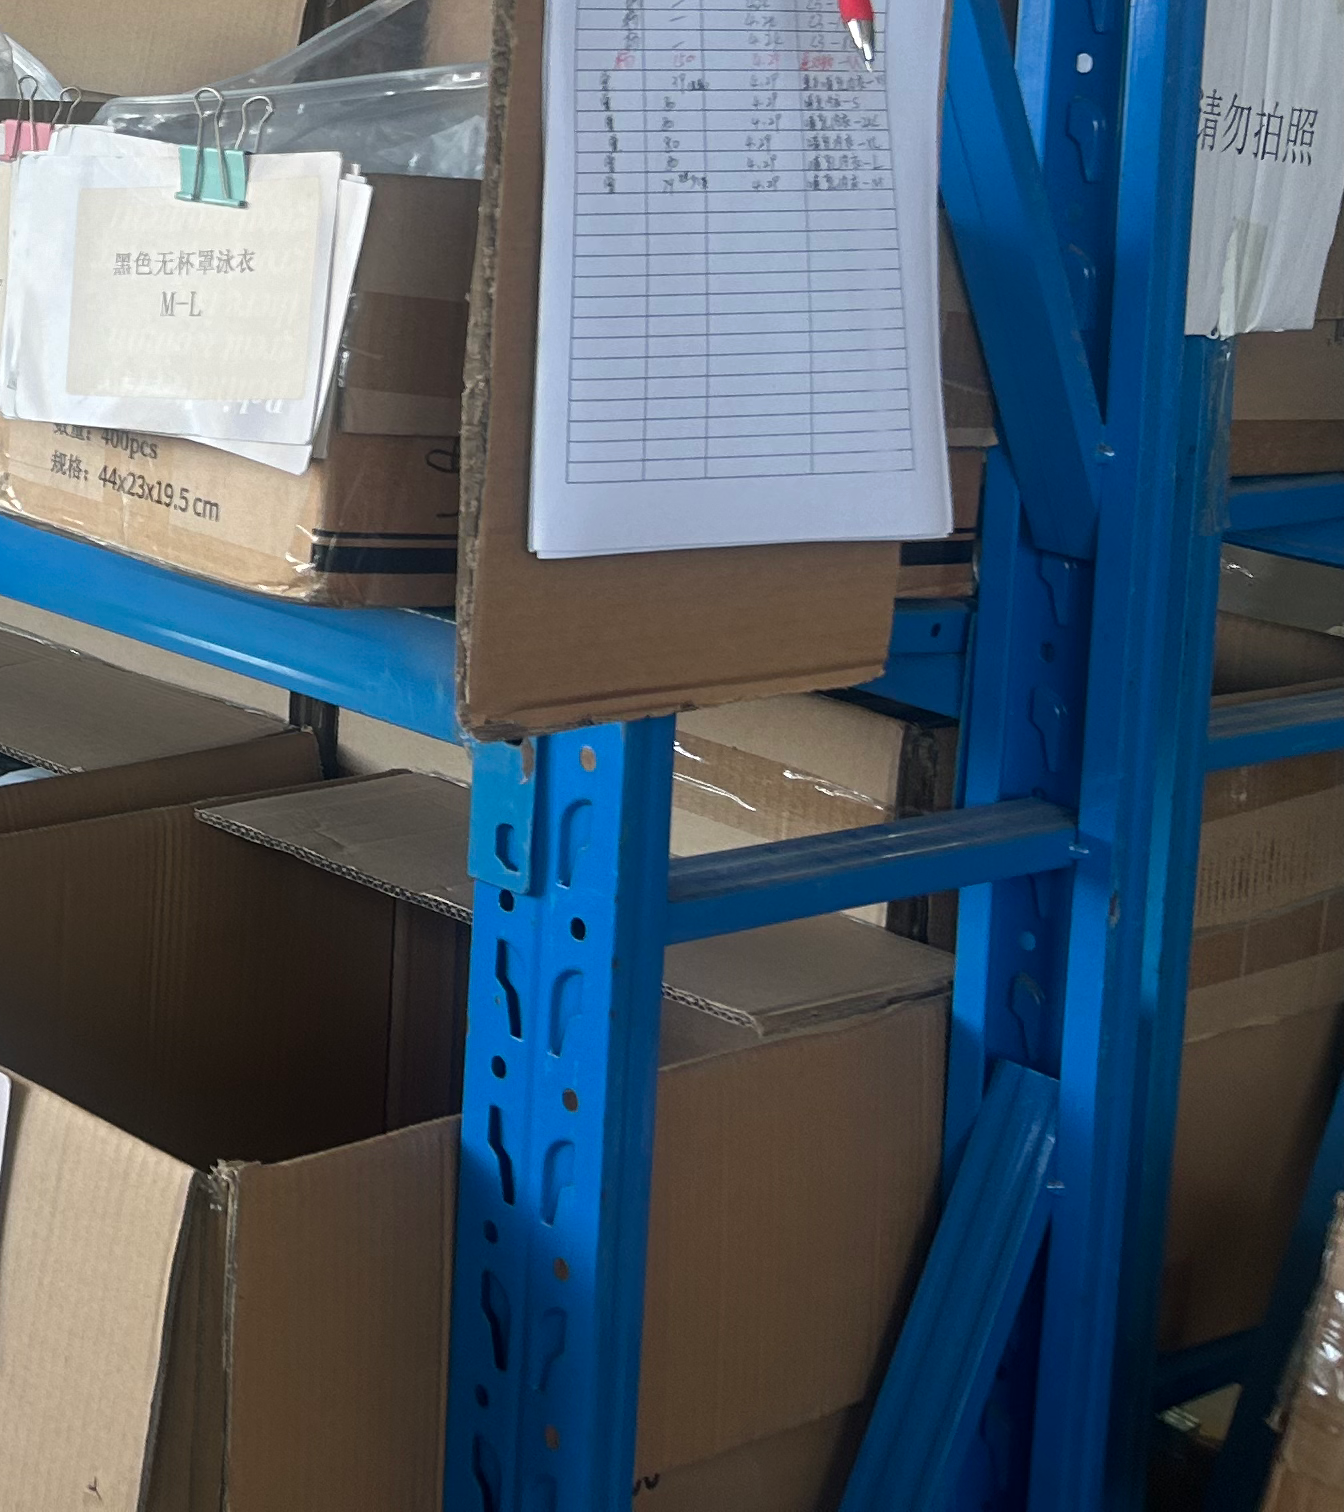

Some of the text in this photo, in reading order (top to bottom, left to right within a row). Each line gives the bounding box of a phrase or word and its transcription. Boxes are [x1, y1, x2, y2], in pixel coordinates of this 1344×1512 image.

[1196, 88, 1319, 166] 请勿拍照
[113, 248, 256, 277] 黑色无杯罩泳衣
[159, 291, 202, 317] M-L
[100, 429, 159, 460] 400pcs
[97, 464, 190, 513] 44x23x19.5
[192, 495, 221, 523] cm
